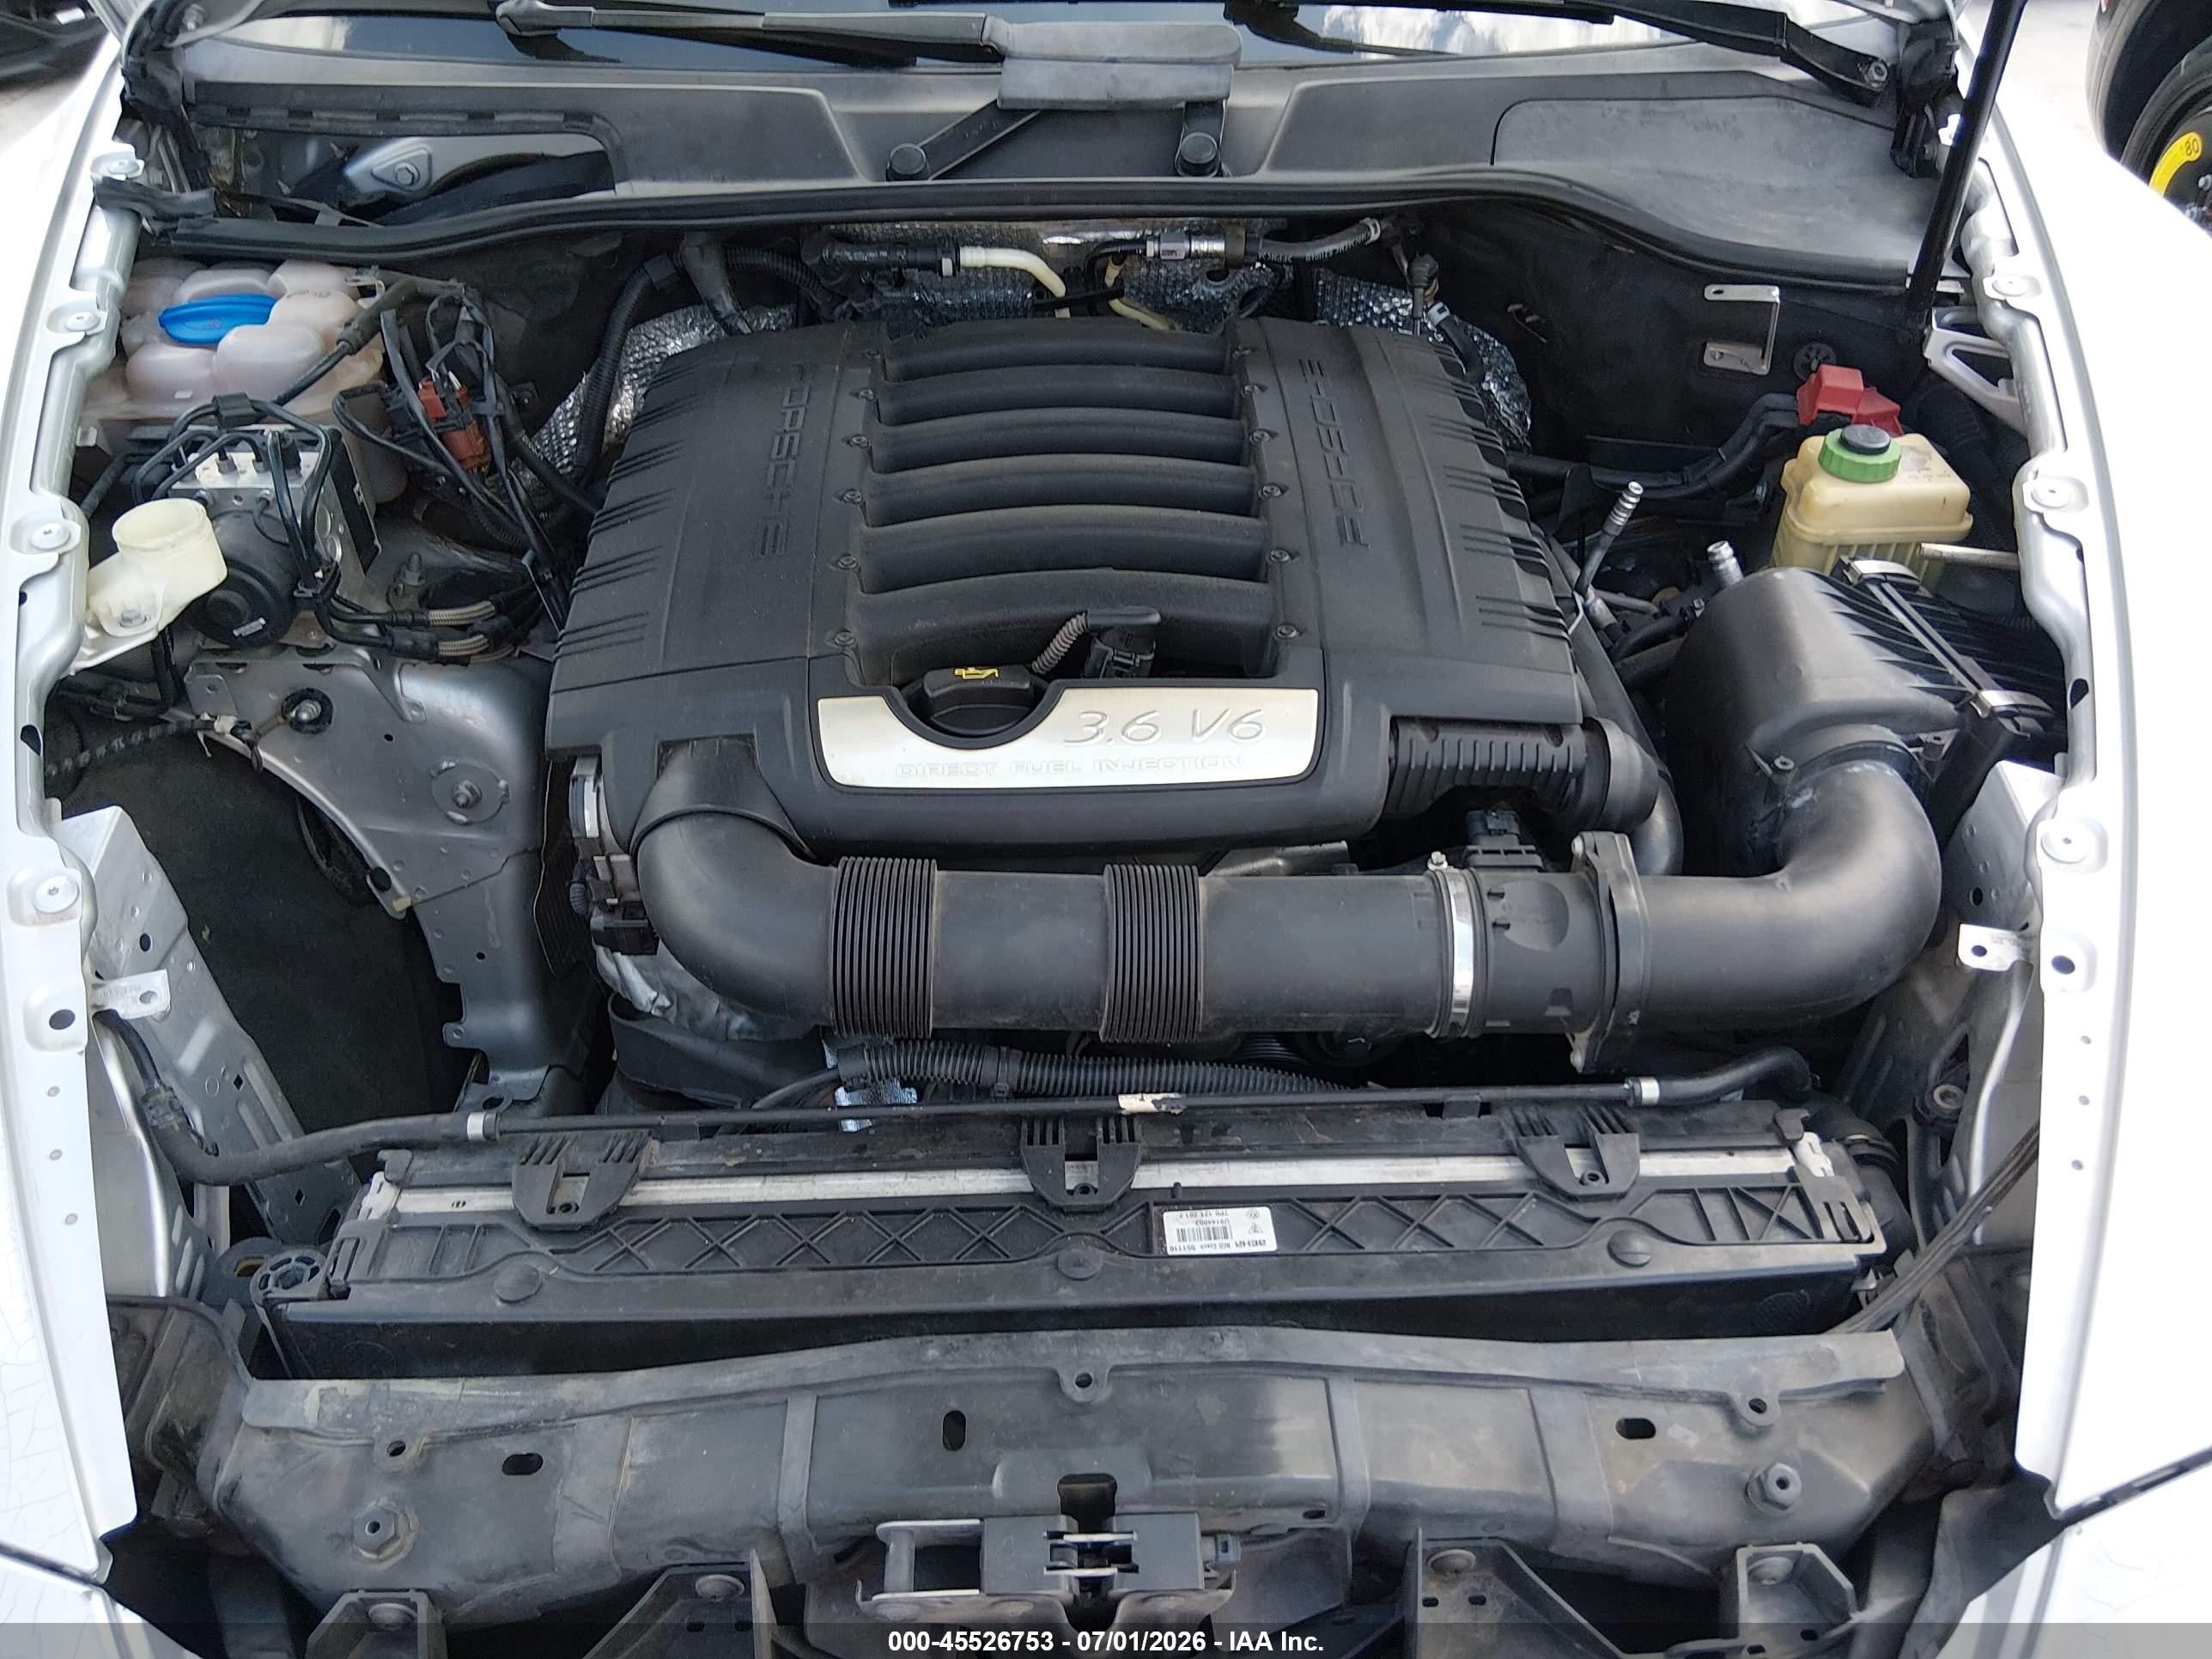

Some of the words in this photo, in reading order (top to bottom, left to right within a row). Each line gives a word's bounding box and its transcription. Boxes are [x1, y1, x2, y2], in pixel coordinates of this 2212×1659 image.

[2185, 138, 2200, 156] 80
[1297, 357, 1370, 548] PORSCHE
[1064, 708, 1163, 746] 3.6
[1191, 707, 1267, 744] V6
[896, 762, 997, 778] DIRECT
[1010, 759, 1081, 775] FUEL
[1092, 755, 1244, 773] INJECTION
